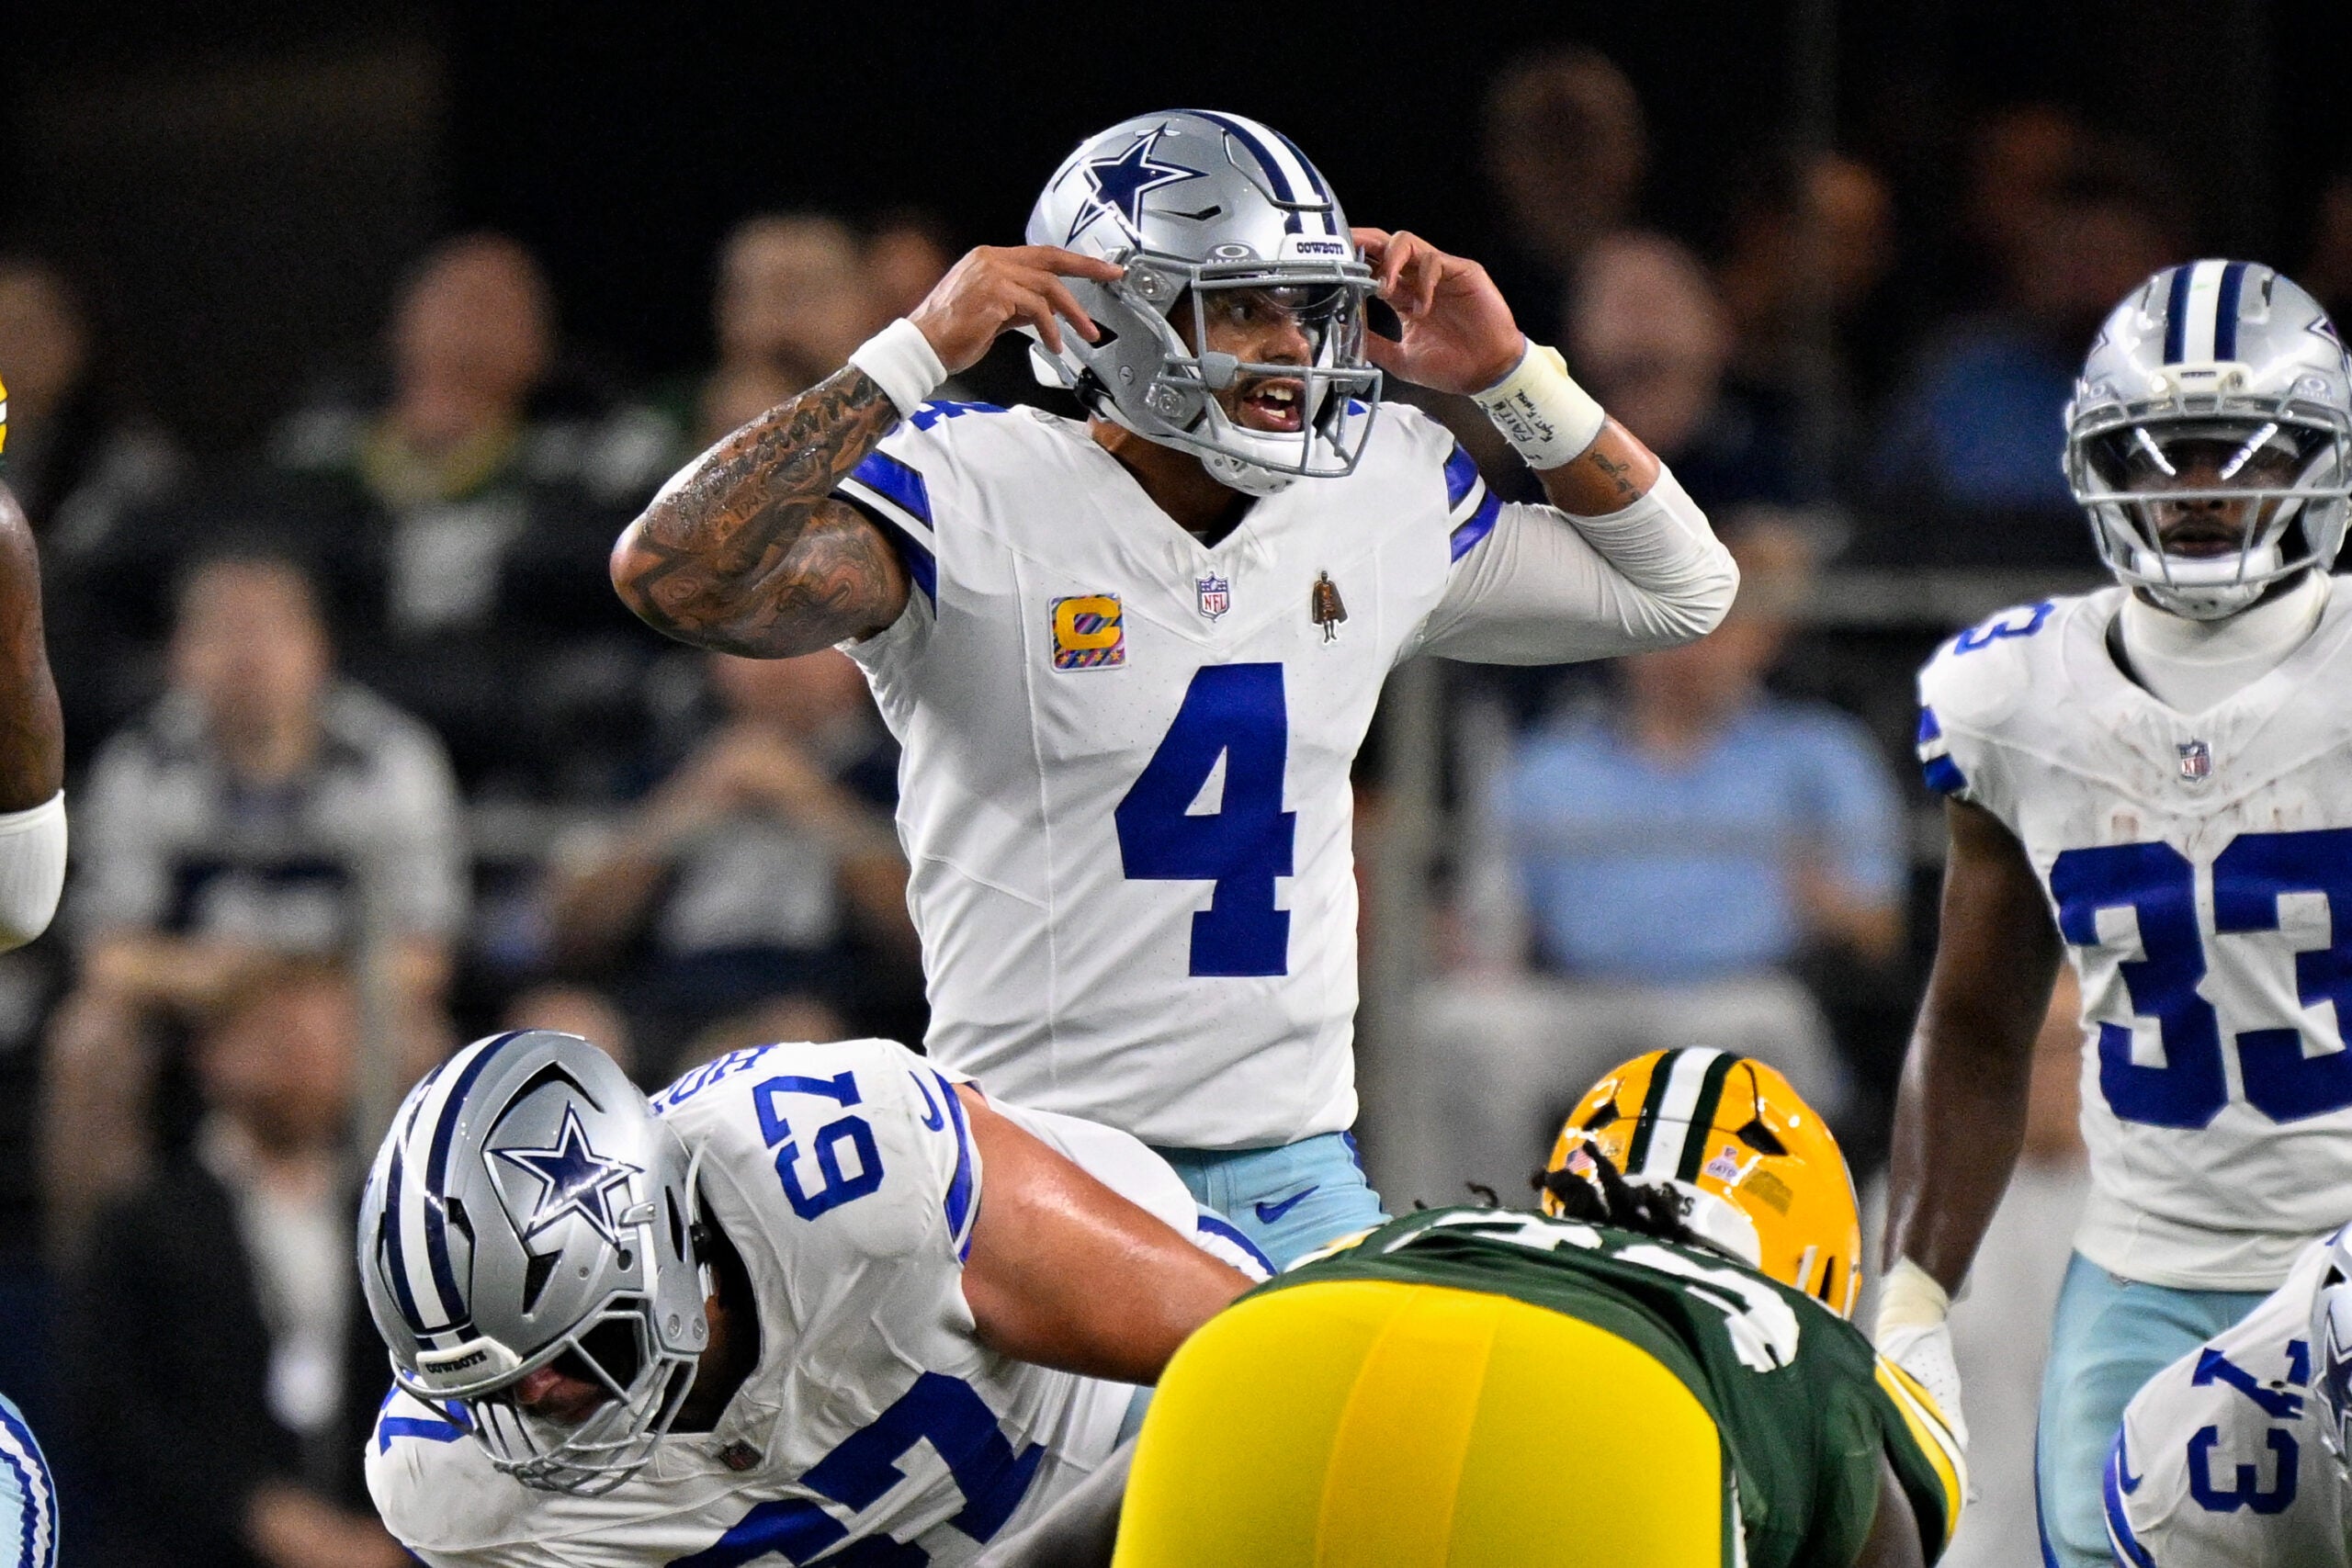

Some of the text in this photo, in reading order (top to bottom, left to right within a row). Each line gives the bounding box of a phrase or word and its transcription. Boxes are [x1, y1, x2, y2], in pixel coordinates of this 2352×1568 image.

[1056, 597, 1121, 649] C
[1204, 594, 1227, 614] NFL
[1114, 661, 1296, 977] 4
[2051, 828, 2352, 1130] 33
[752, 1070, 885, 1222] 67
[2188, 1339, 2312, 1515] 73
